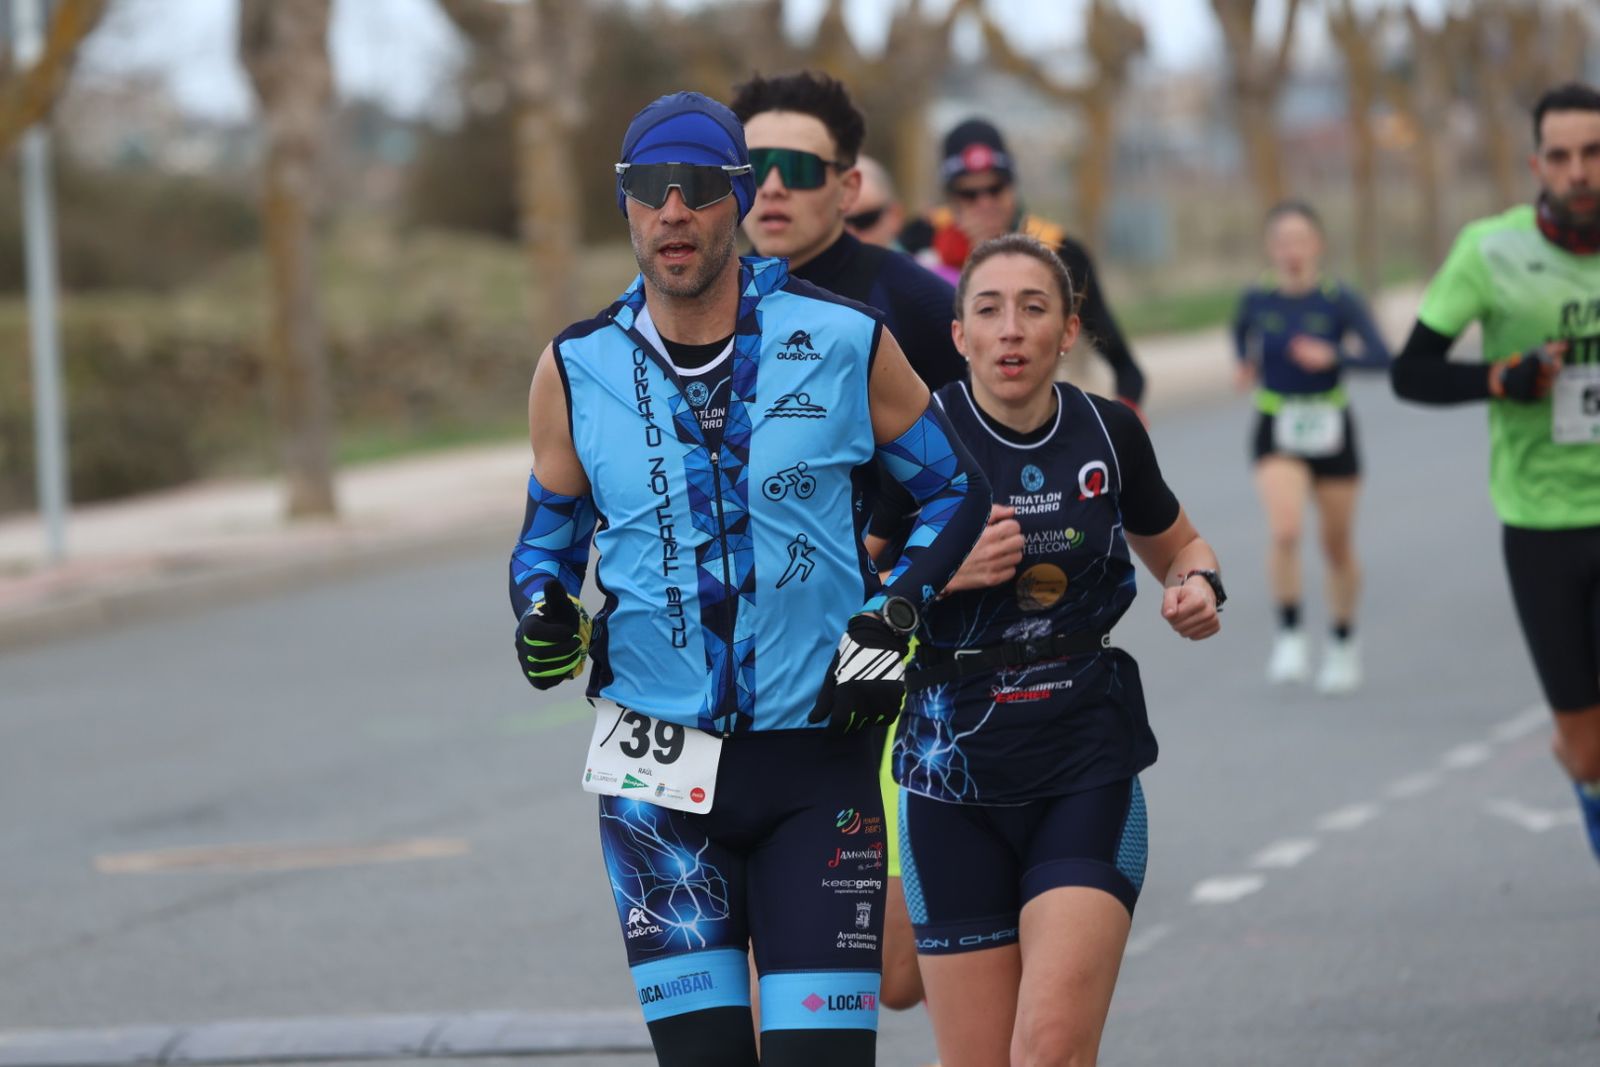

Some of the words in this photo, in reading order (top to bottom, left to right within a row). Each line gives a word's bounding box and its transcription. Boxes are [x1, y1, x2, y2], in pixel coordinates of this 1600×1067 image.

[632, 347, 662, 447] CHARRO
[1009, 492, 1062, 505] TRIATLON
[1015, 502, 1060, 515] CHARRO
[647, 456, 679, 577] TRIATLÓN
[1023, 541, 1071, 555] TELECOM
[665, 586, 687, 649] CLUB
[620, 710, 685, 765] 39
[837, 940, 847, 948] de
